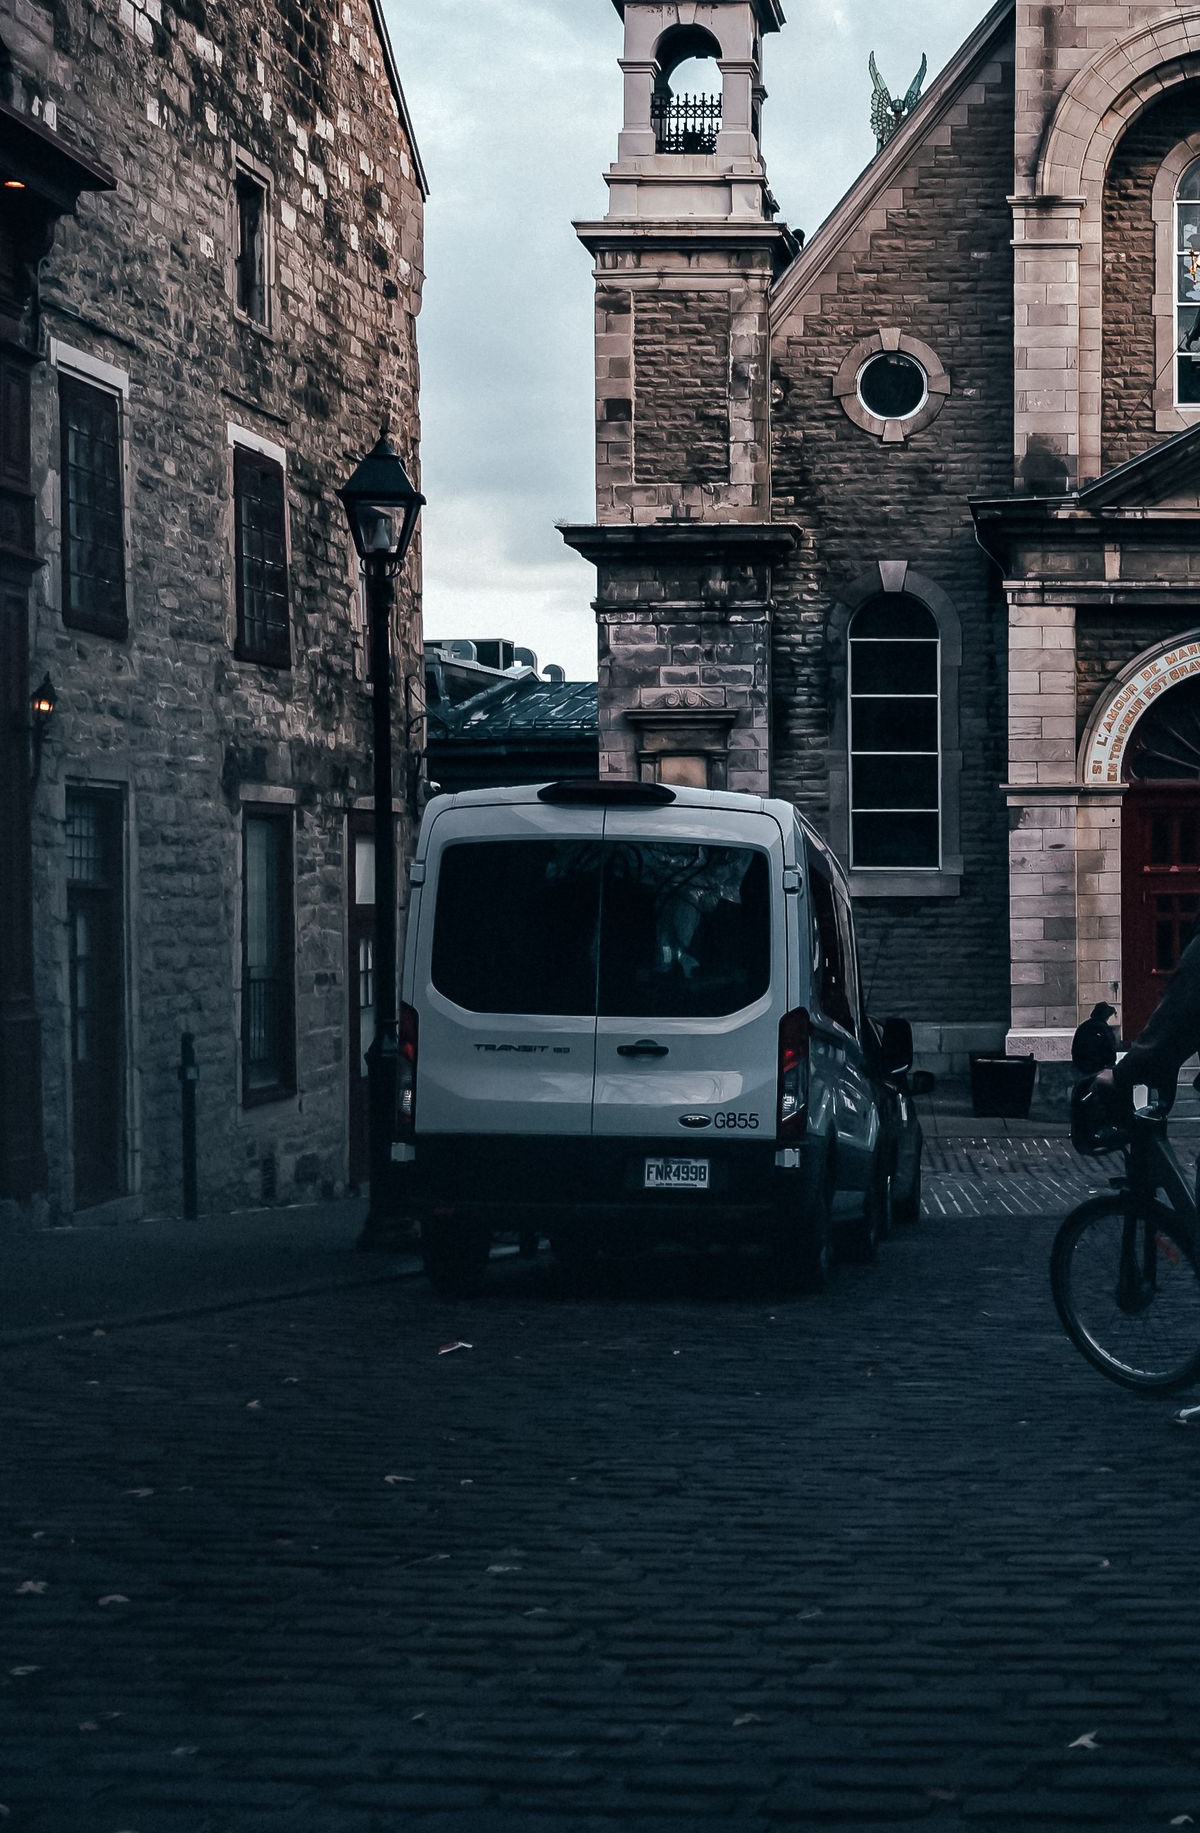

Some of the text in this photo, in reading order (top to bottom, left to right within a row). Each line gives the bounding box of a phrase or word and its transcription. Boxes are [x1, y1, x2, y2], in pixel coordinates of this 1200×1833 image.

[1143, 676, 1168, 700] EST
[1092, 760, 1102, 774] SI
[1140, 663, 1161, 681] DE
[1109, 735, 1124, 760] TON
[1107, 763, 1118, 781] EN
[473, 1044, 549, 1052] TRANSIT
[714, 1112, 759, 1128] G855
